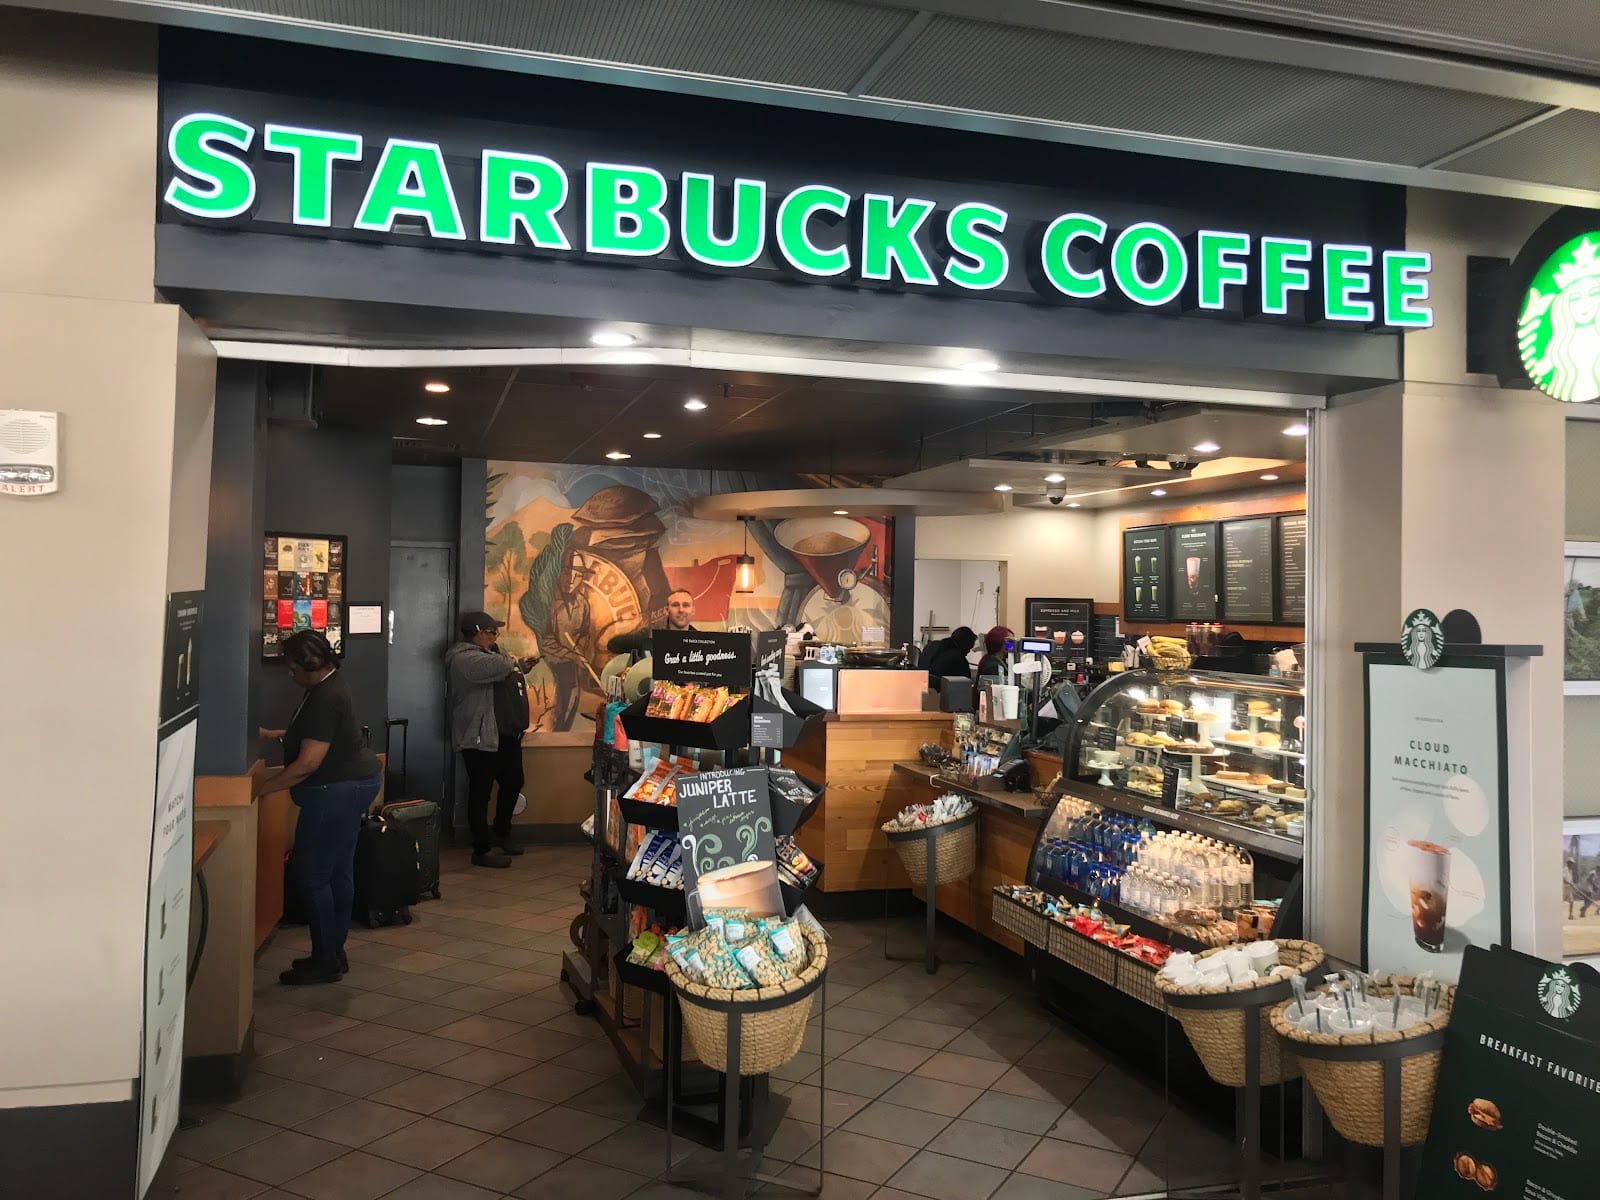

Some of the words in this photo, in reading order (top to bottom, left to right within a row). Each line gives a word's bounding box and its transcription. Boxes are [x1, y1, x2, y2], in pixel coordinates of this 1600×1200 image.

[164, 112, 1010, 291] STARBUCKS
[1041, 212, 1434, 328] COFFEE
[1, 484, 45, 493] ALERT
[664, 652, 681, 665] Grab
[682, 655, 687, 663] a
[689, 649, 704, 663] little
[705, 648, 737, 666] goodness.
[1409, 739, 1450, 754] CLOUD
[700, 768, 746, 781] INTRODUCING
[1394, 755, 1468, 775] MACCHIATO
[679, 779, 733, 799] JUNIPER
[712, 789, 757, 809] LATTE
[1479, 1034, 1543, 1069] BREAKFAST
